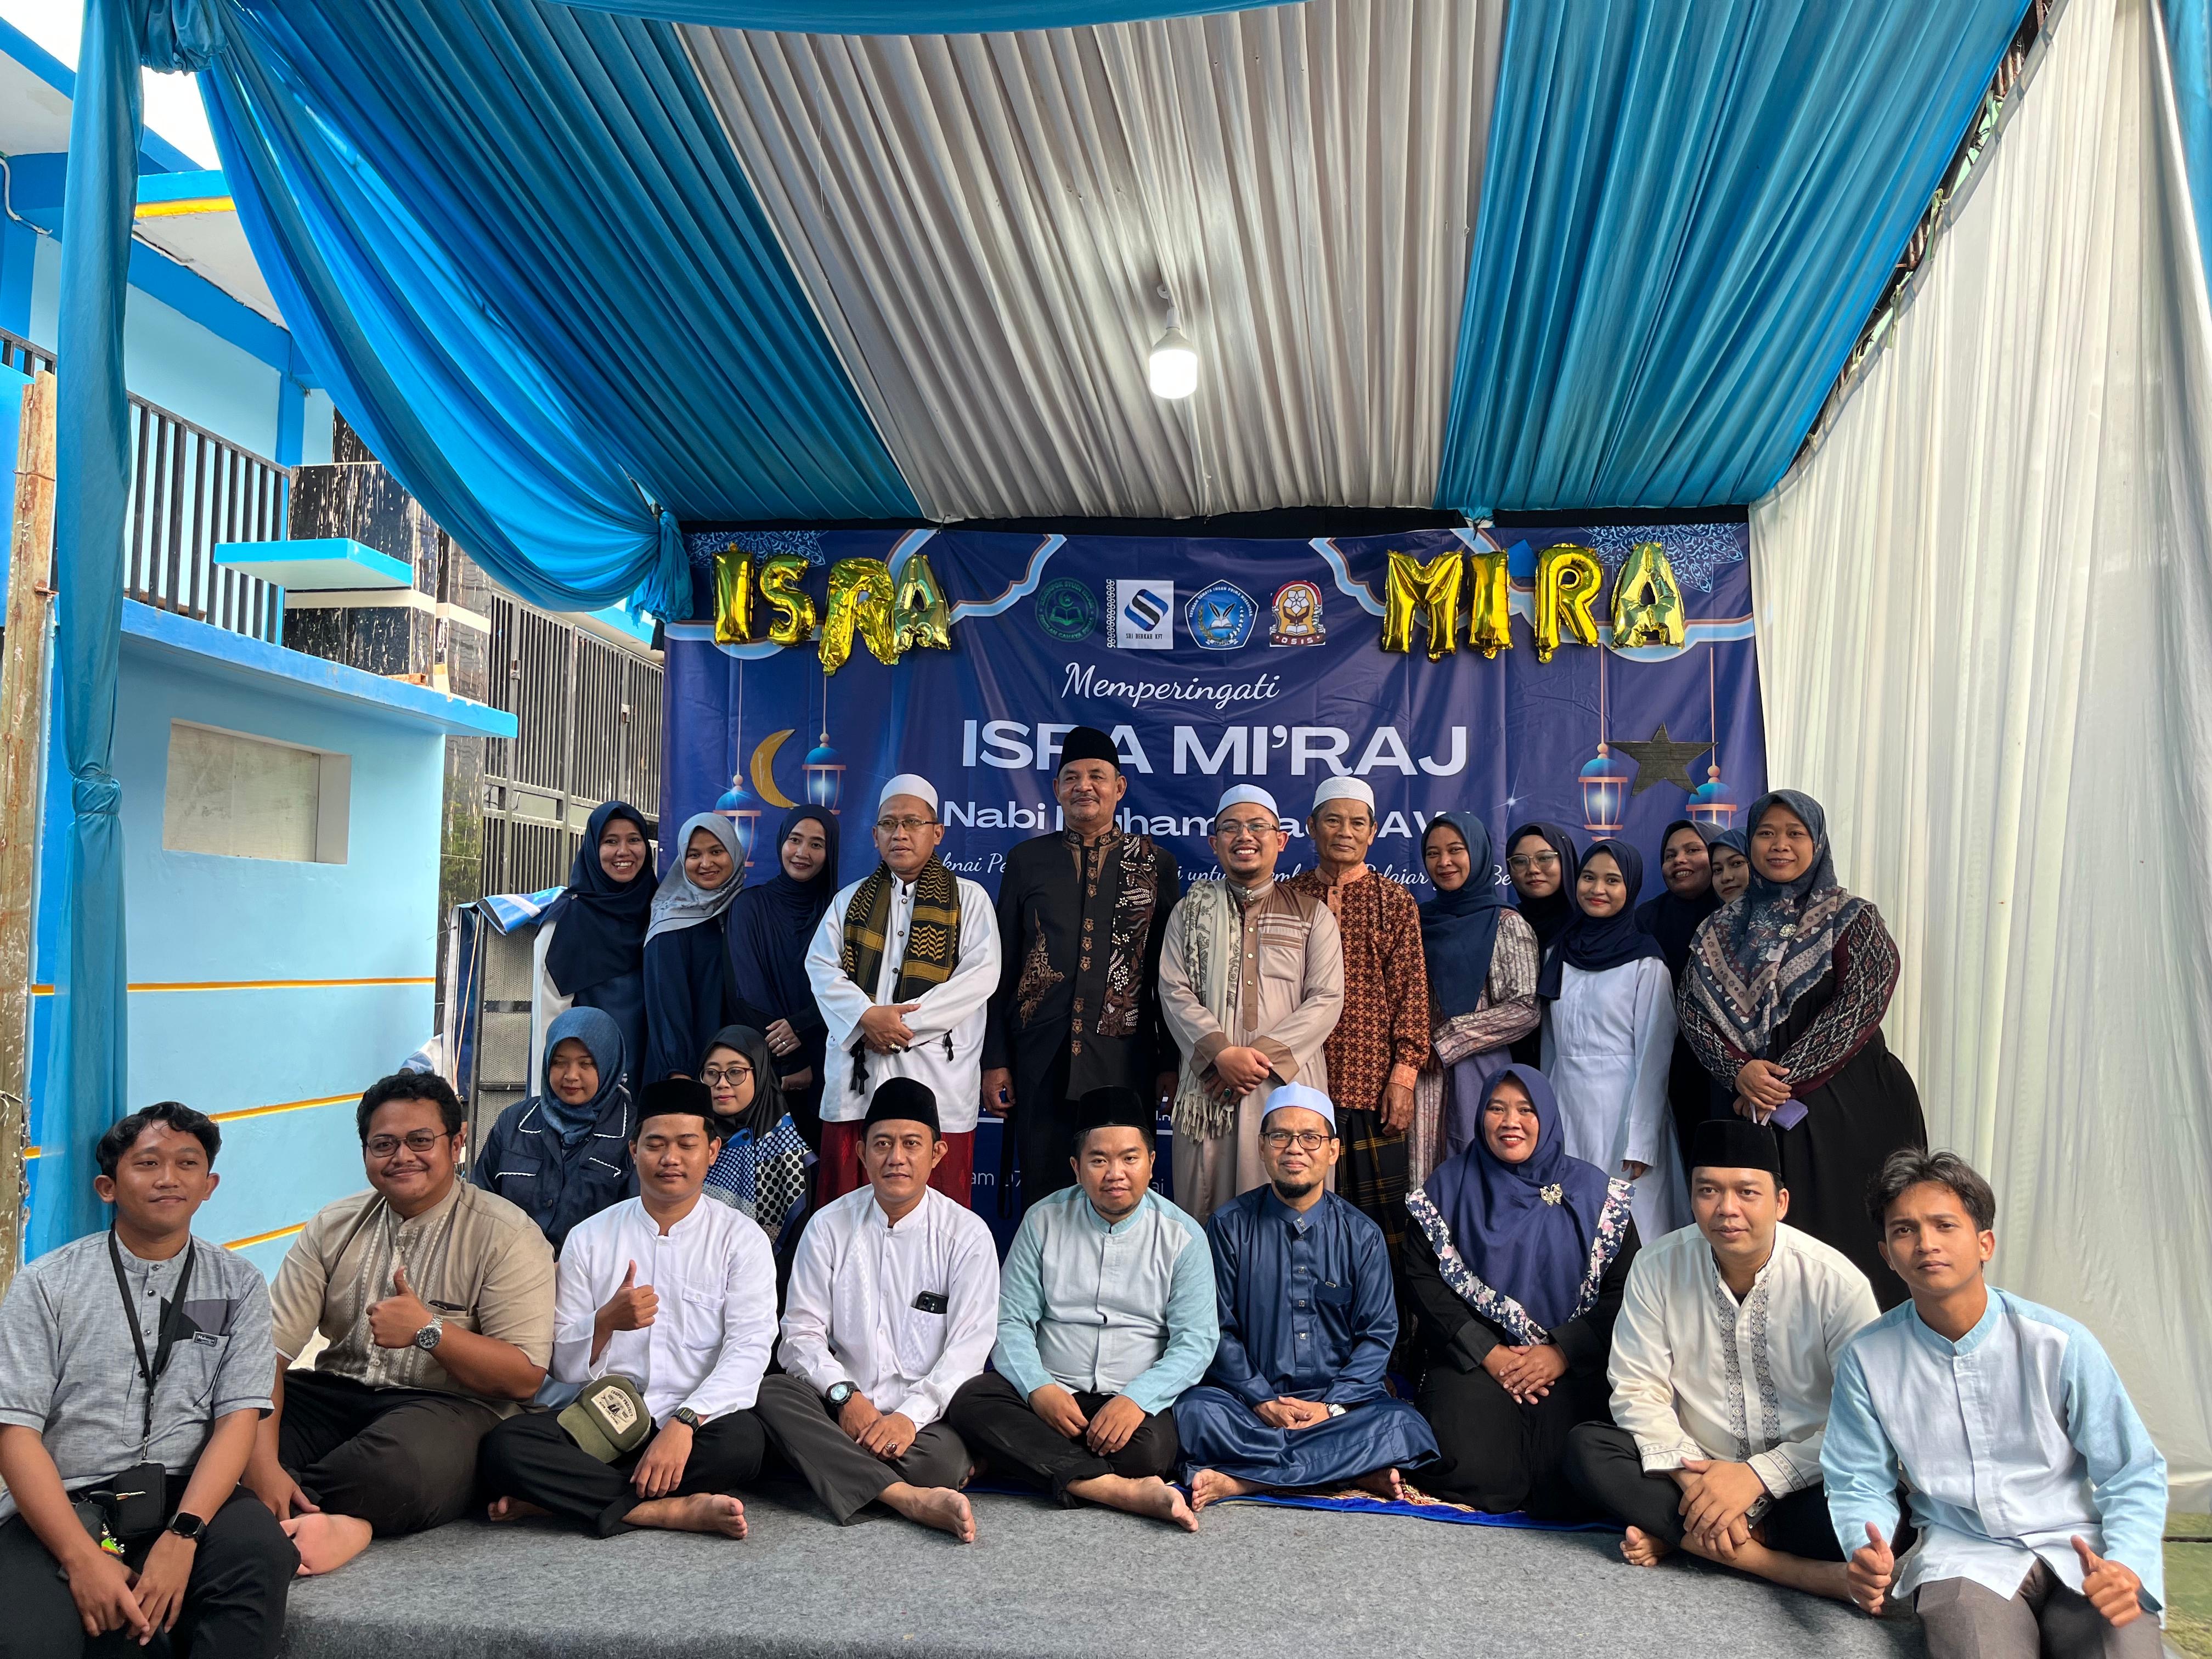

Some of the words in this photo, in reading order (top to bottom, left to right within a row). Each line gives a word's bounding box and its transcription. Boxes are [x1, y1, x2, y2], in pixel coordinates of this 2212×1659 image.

[713, 543, 951, 676] ISRA
[1198, 589, 1212, 600] CAHAYA
[1228, 588, 1241, 596] PRIMA
[1061, 662, 1280, 710] Memperingati
[1173, 725, 1467, 776] MI'RAJ
[943, 800, 1046, 831] Nabi
[1188, 865, 1226, 882] untu
